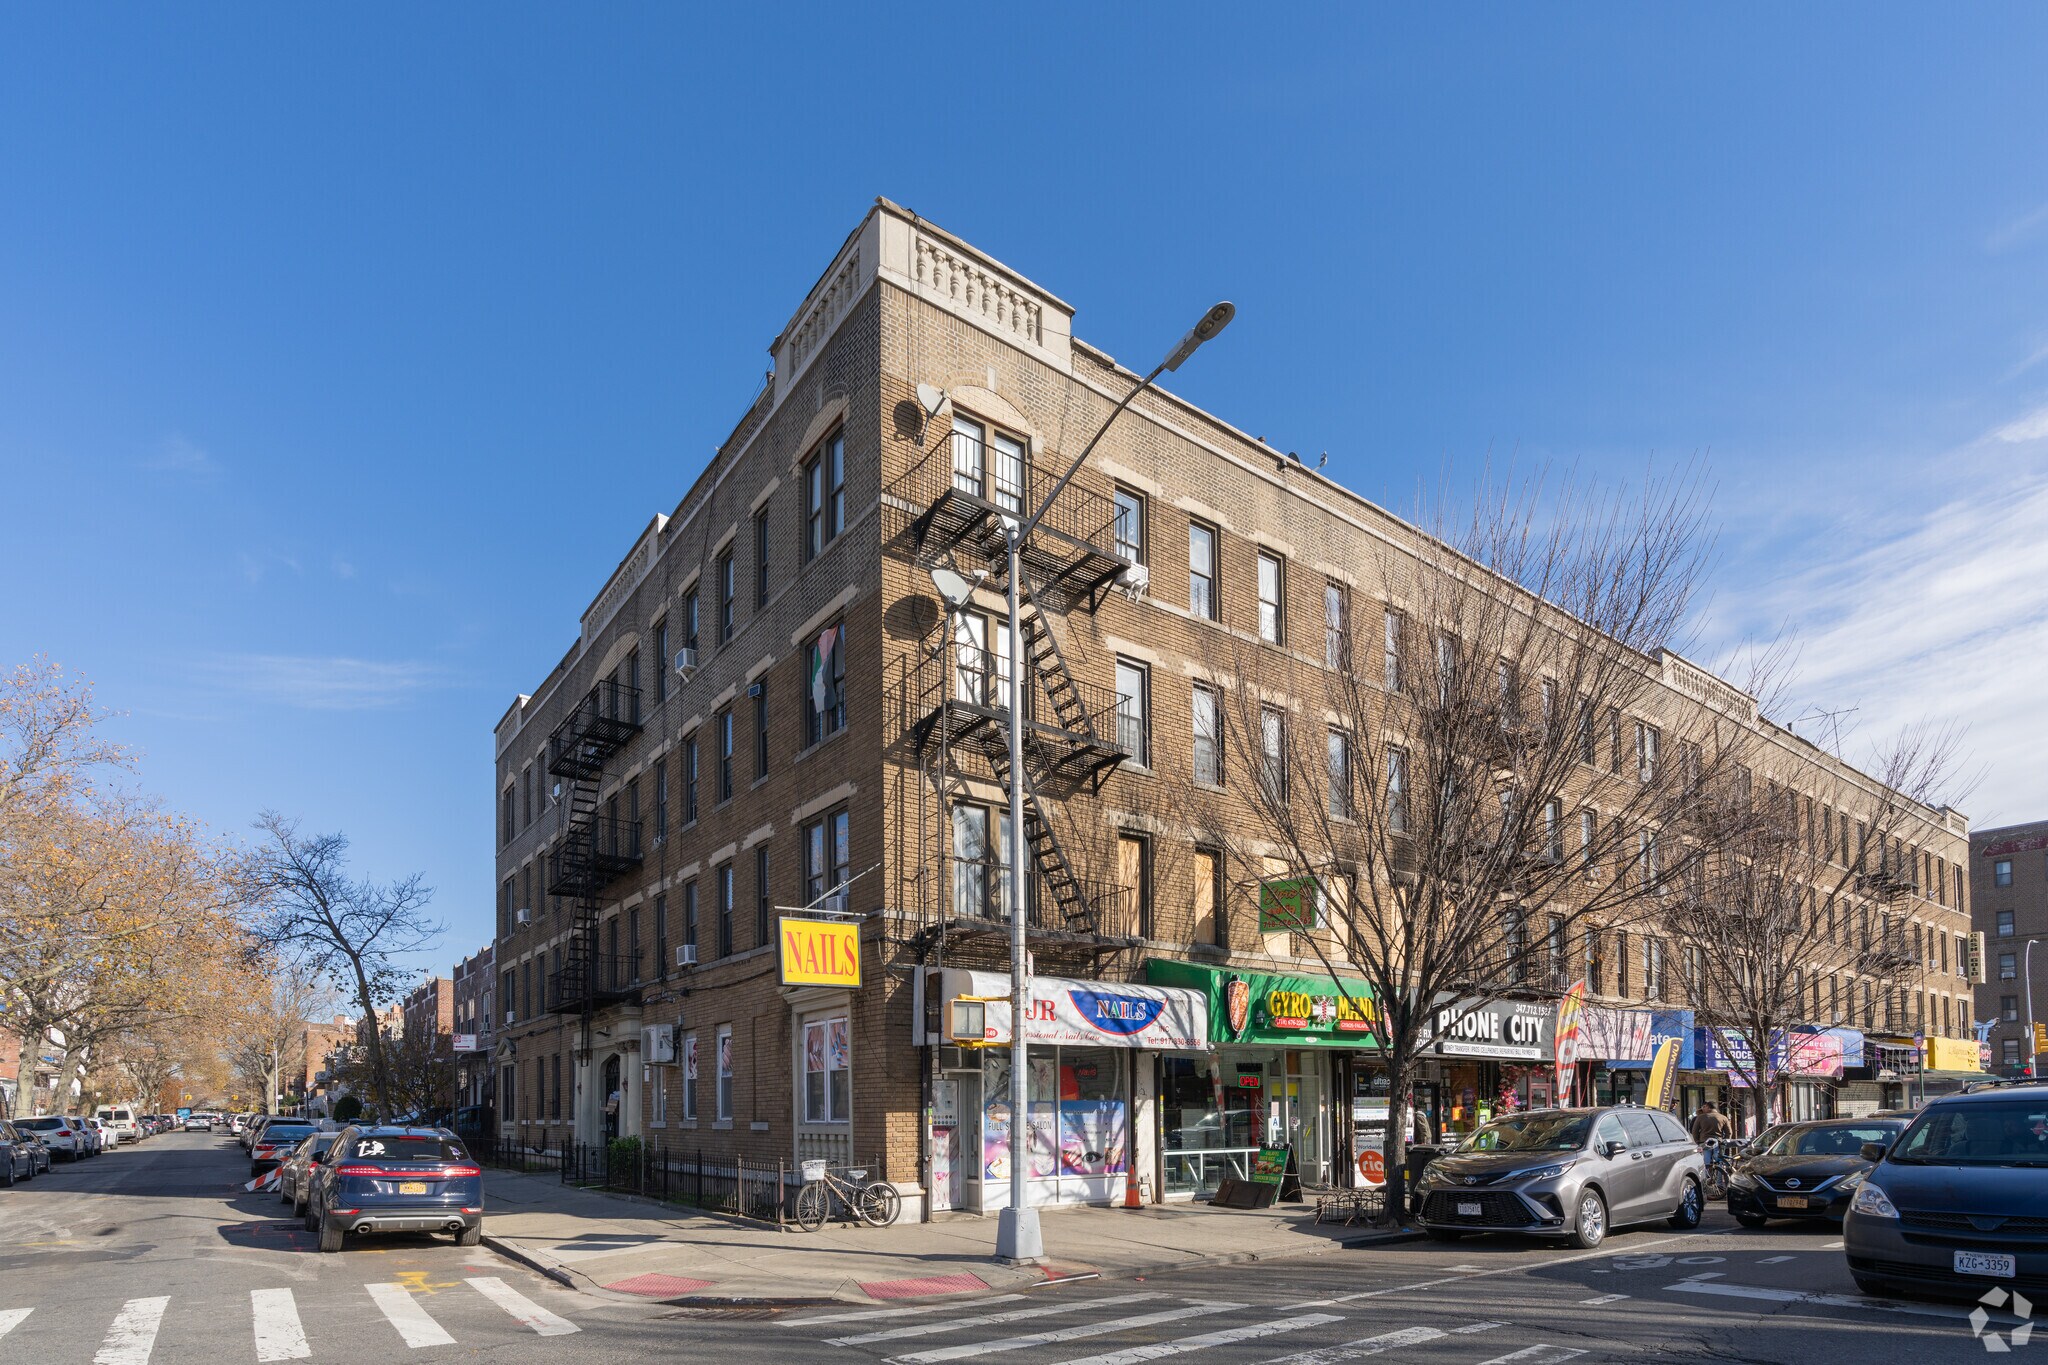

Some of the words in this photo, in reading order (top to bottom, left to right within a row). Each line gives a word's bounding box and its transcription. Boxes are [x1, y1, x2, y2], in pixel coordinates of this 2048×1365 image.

[785, 931, 856, 977] NAILS
[1096, 999, 1147, 1021] NAILS
[1269, 990, 1312, 1019] GYRO
[1439, 1008, 1499, 1039] PHONE
[1510, 1014, 1544, 1042] CITY
[1147, 1036, 1159, 1045] Tel:
[1714, 1050, 1721, 1059] &
[1240, 1075, 1259, 1087] OPEN
[988, 1122, 1003, 1131] FULL
[1032, 1121, 1052, 1130] SALON
[1272, 1118, 1278, 1126] A
